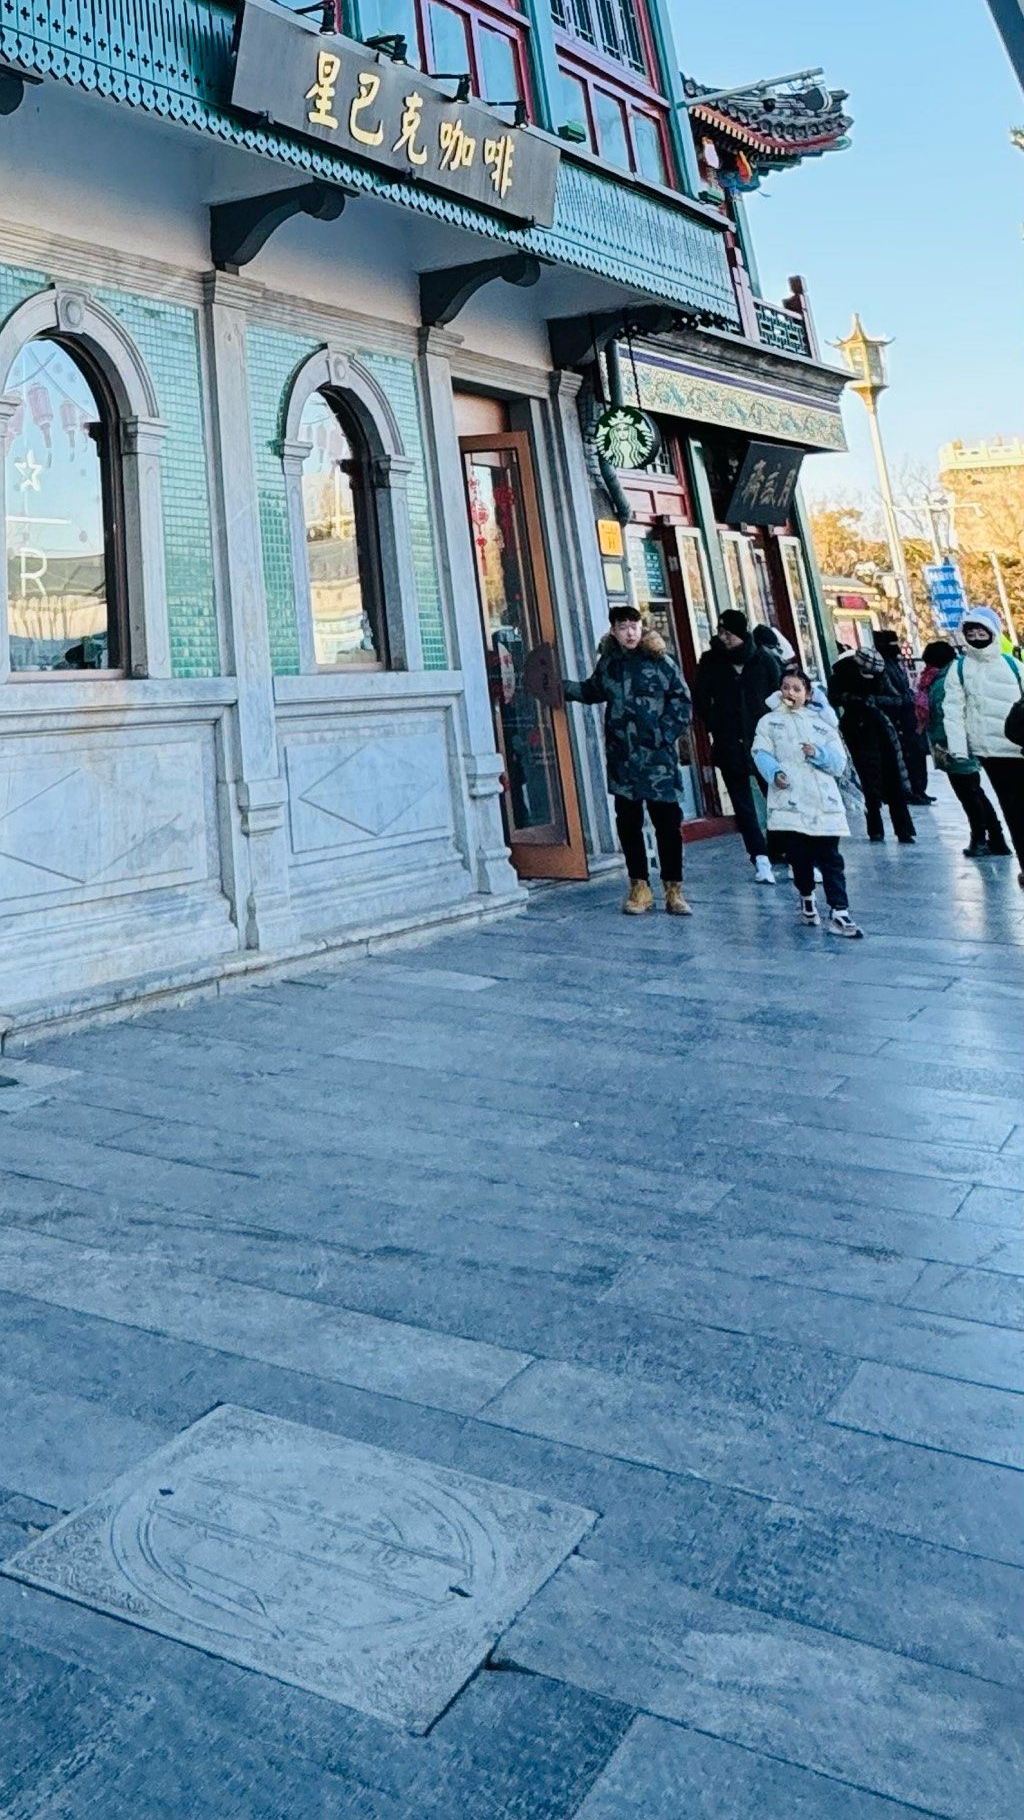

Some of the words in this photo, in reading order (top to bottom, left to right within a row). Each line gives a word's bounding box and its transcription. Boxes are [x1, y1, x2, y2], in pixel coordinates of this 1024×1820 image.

[305, 51, 514, 199] 星巴克咖啡
[20, 547, 48, 597] R
